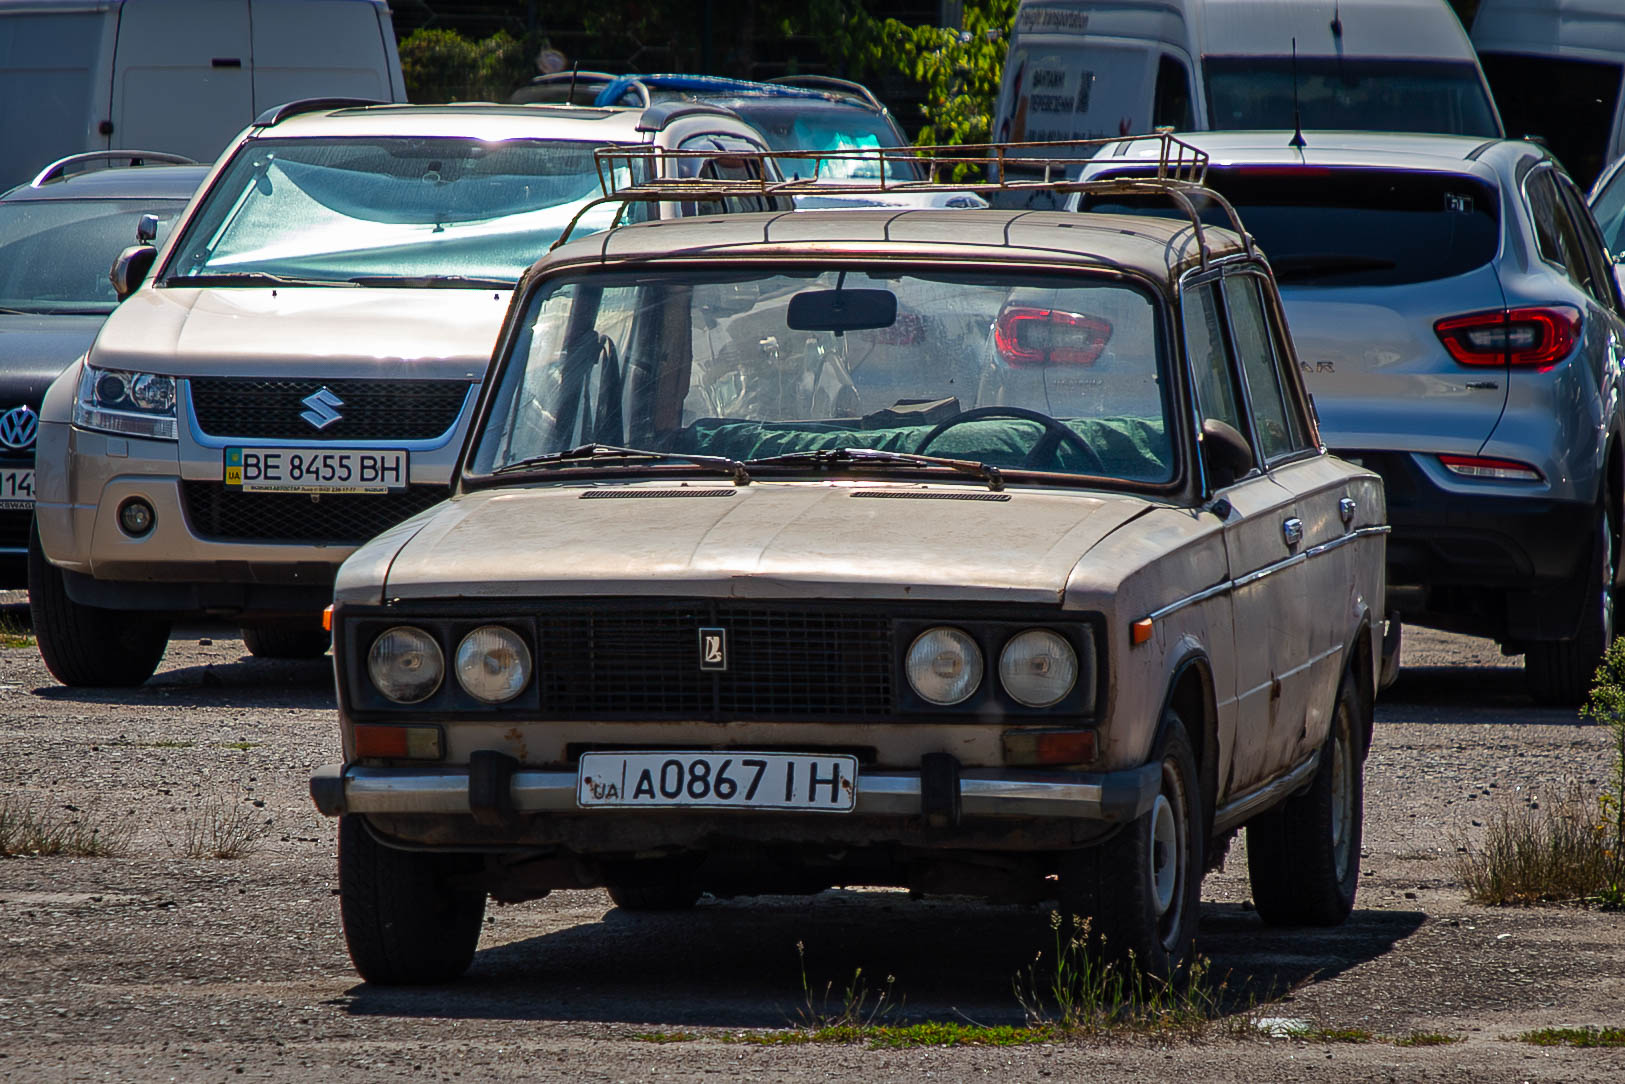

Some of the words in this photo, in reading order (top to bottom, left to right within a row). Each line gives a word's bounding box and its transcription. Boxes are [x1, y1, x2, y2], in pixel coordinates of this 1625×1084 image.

[243, 454, 282, 480] BE
[289, 454, 352, 482] 8455
[360, 455, 400, 482] BH
